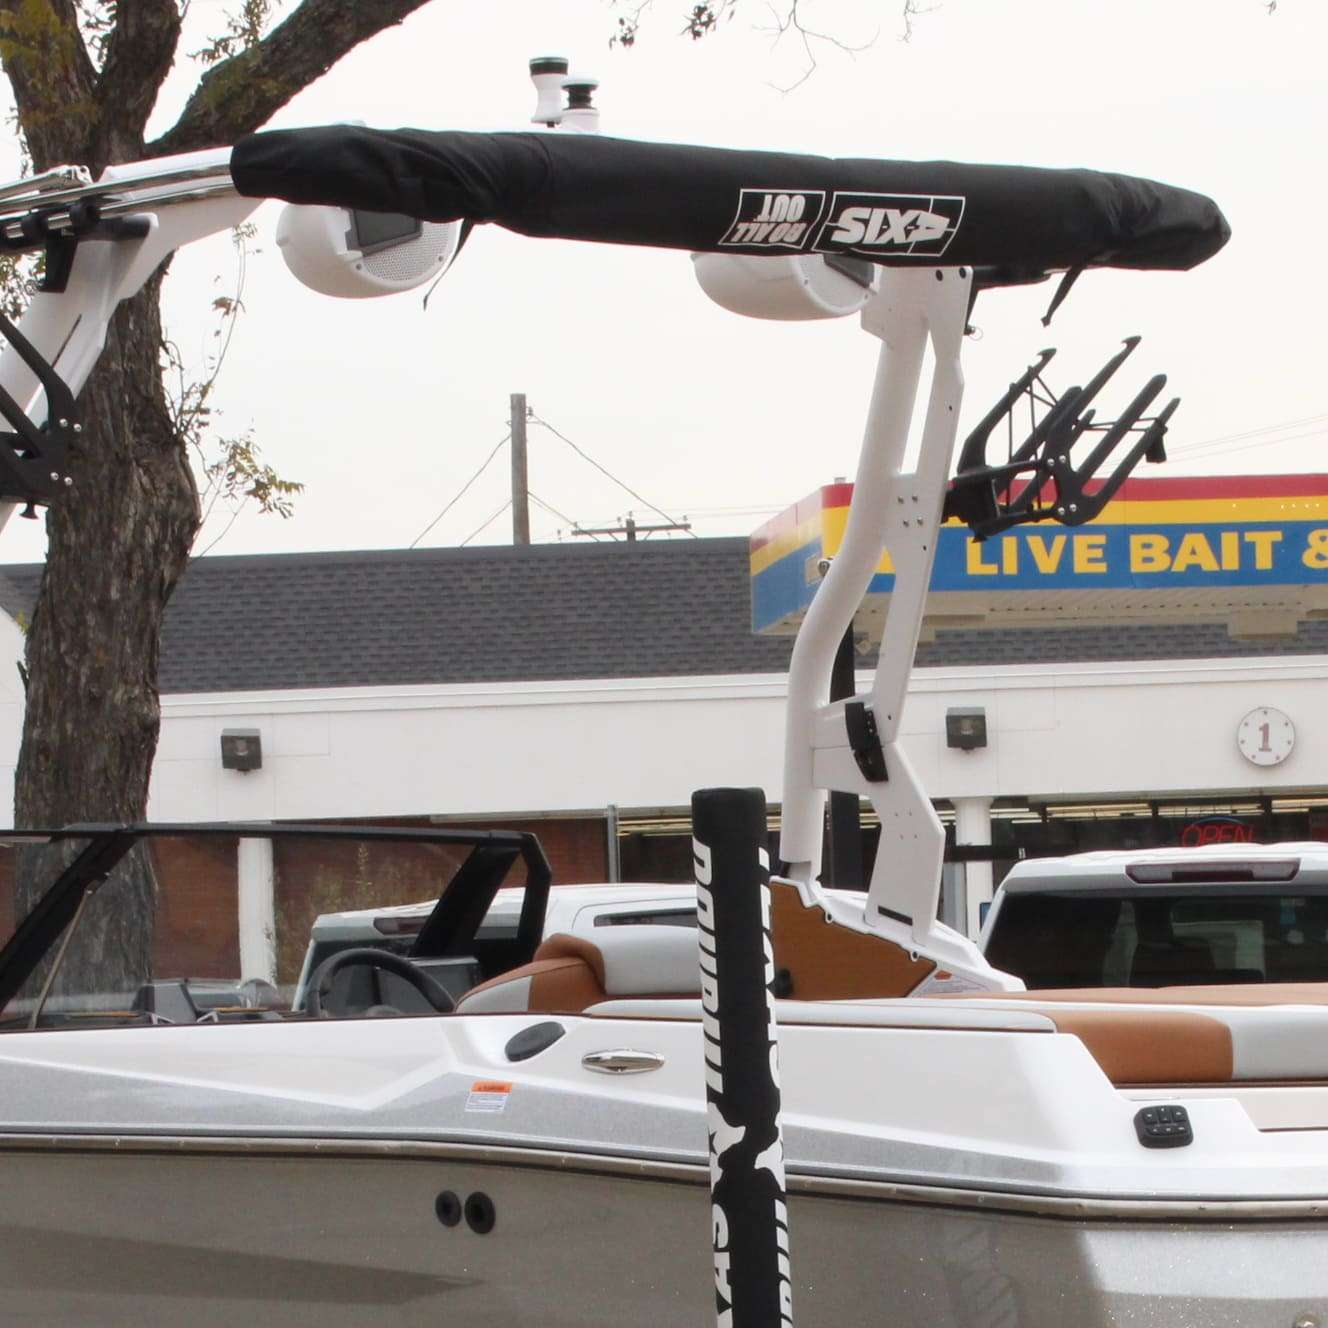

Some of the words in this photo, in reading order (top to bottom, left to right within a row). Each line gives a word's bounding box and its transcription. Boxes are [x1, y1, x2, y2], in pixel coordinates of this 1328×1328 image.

[966, 534, 1108, 575] LIVE
[1129, 531, 1283, 573] BAIT
[1258, 722, 1272, 752] 1
[1182, 824, 1254, 849] OPEN
